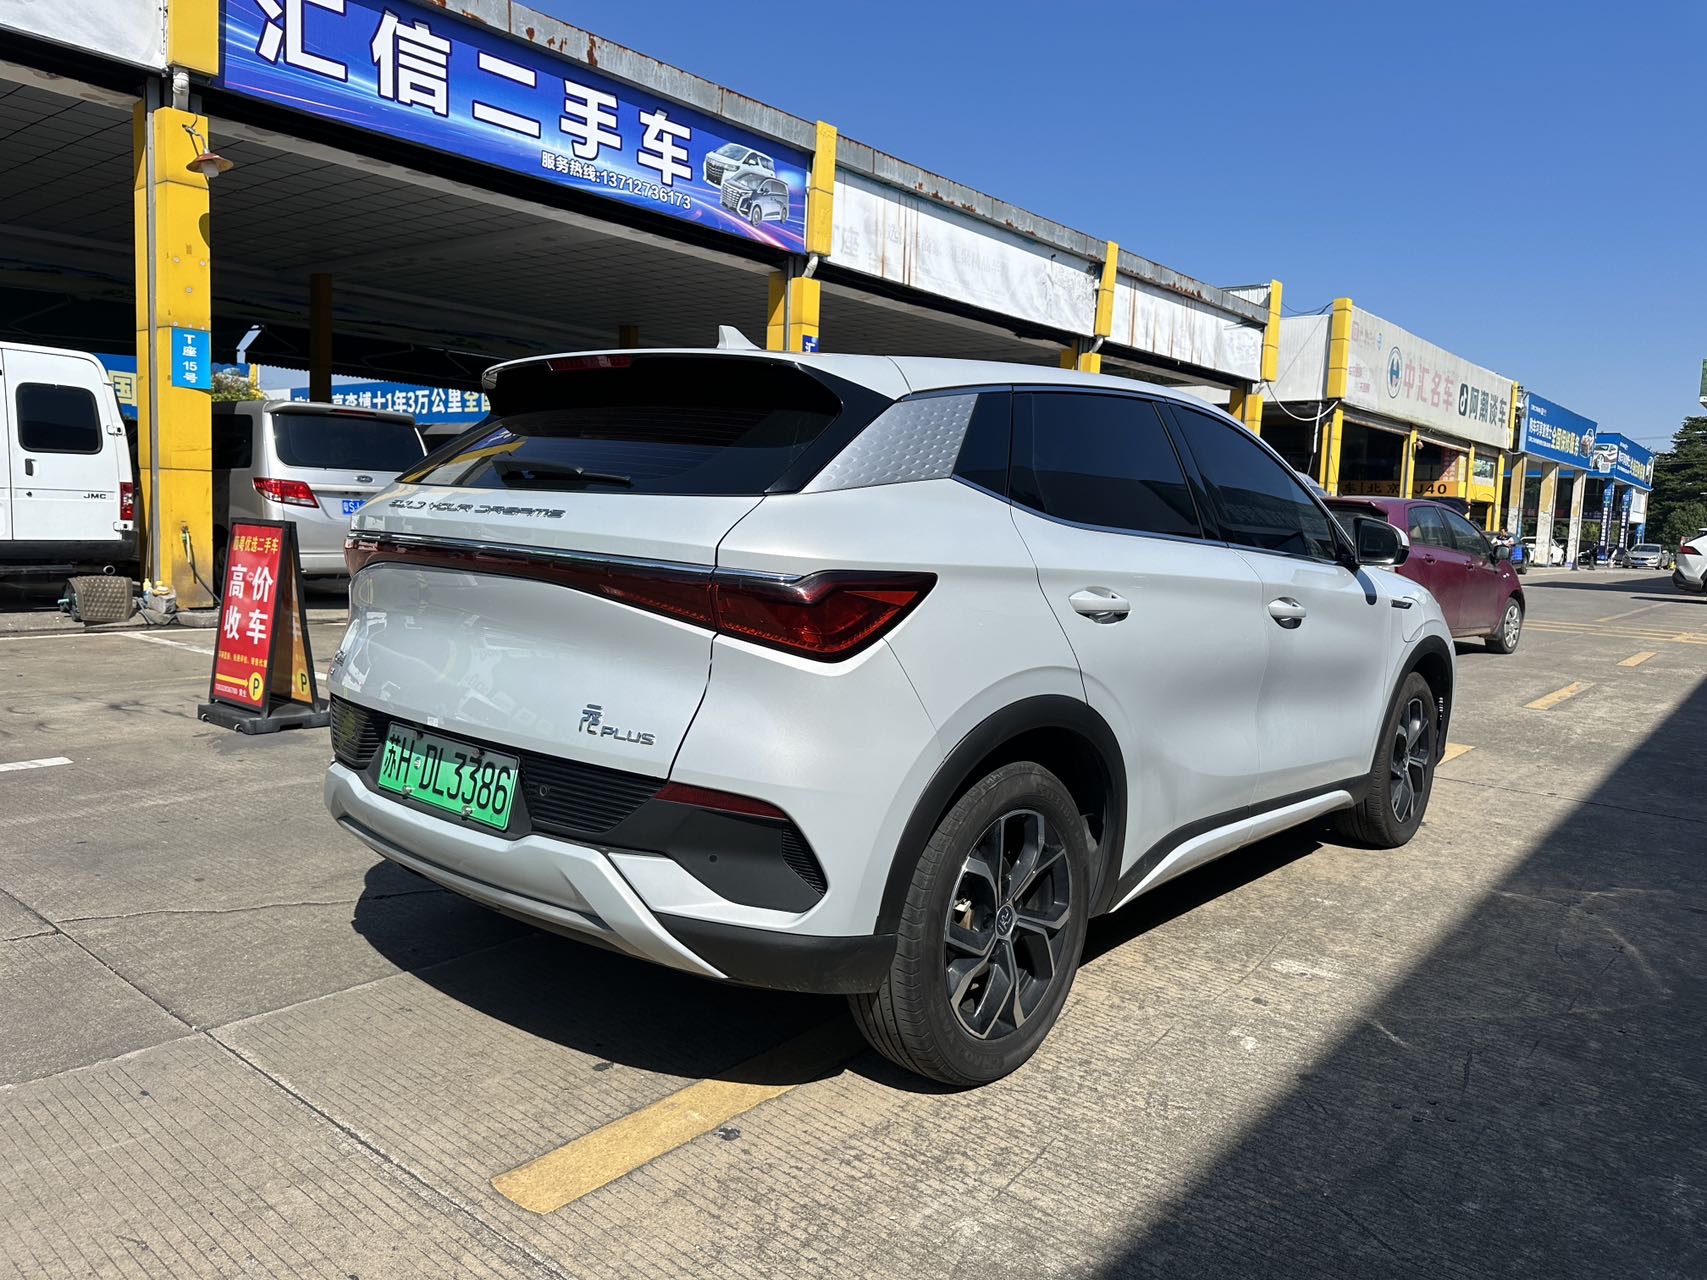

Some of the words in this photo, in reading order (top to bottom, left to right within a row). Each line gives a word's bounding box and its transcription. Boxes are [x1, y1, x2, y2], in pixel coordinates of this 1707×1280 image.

[255, 0, 693, 187] 汇信二手车
[540, 150, 692, 210] 服务热线:13712736173
[1403, 358, 1455, 413] 中汇名车
[228, 563, 274, 603] 高价
[223, 605, 269, 645] 收车
[600, 725, 656, 746] PLUS
